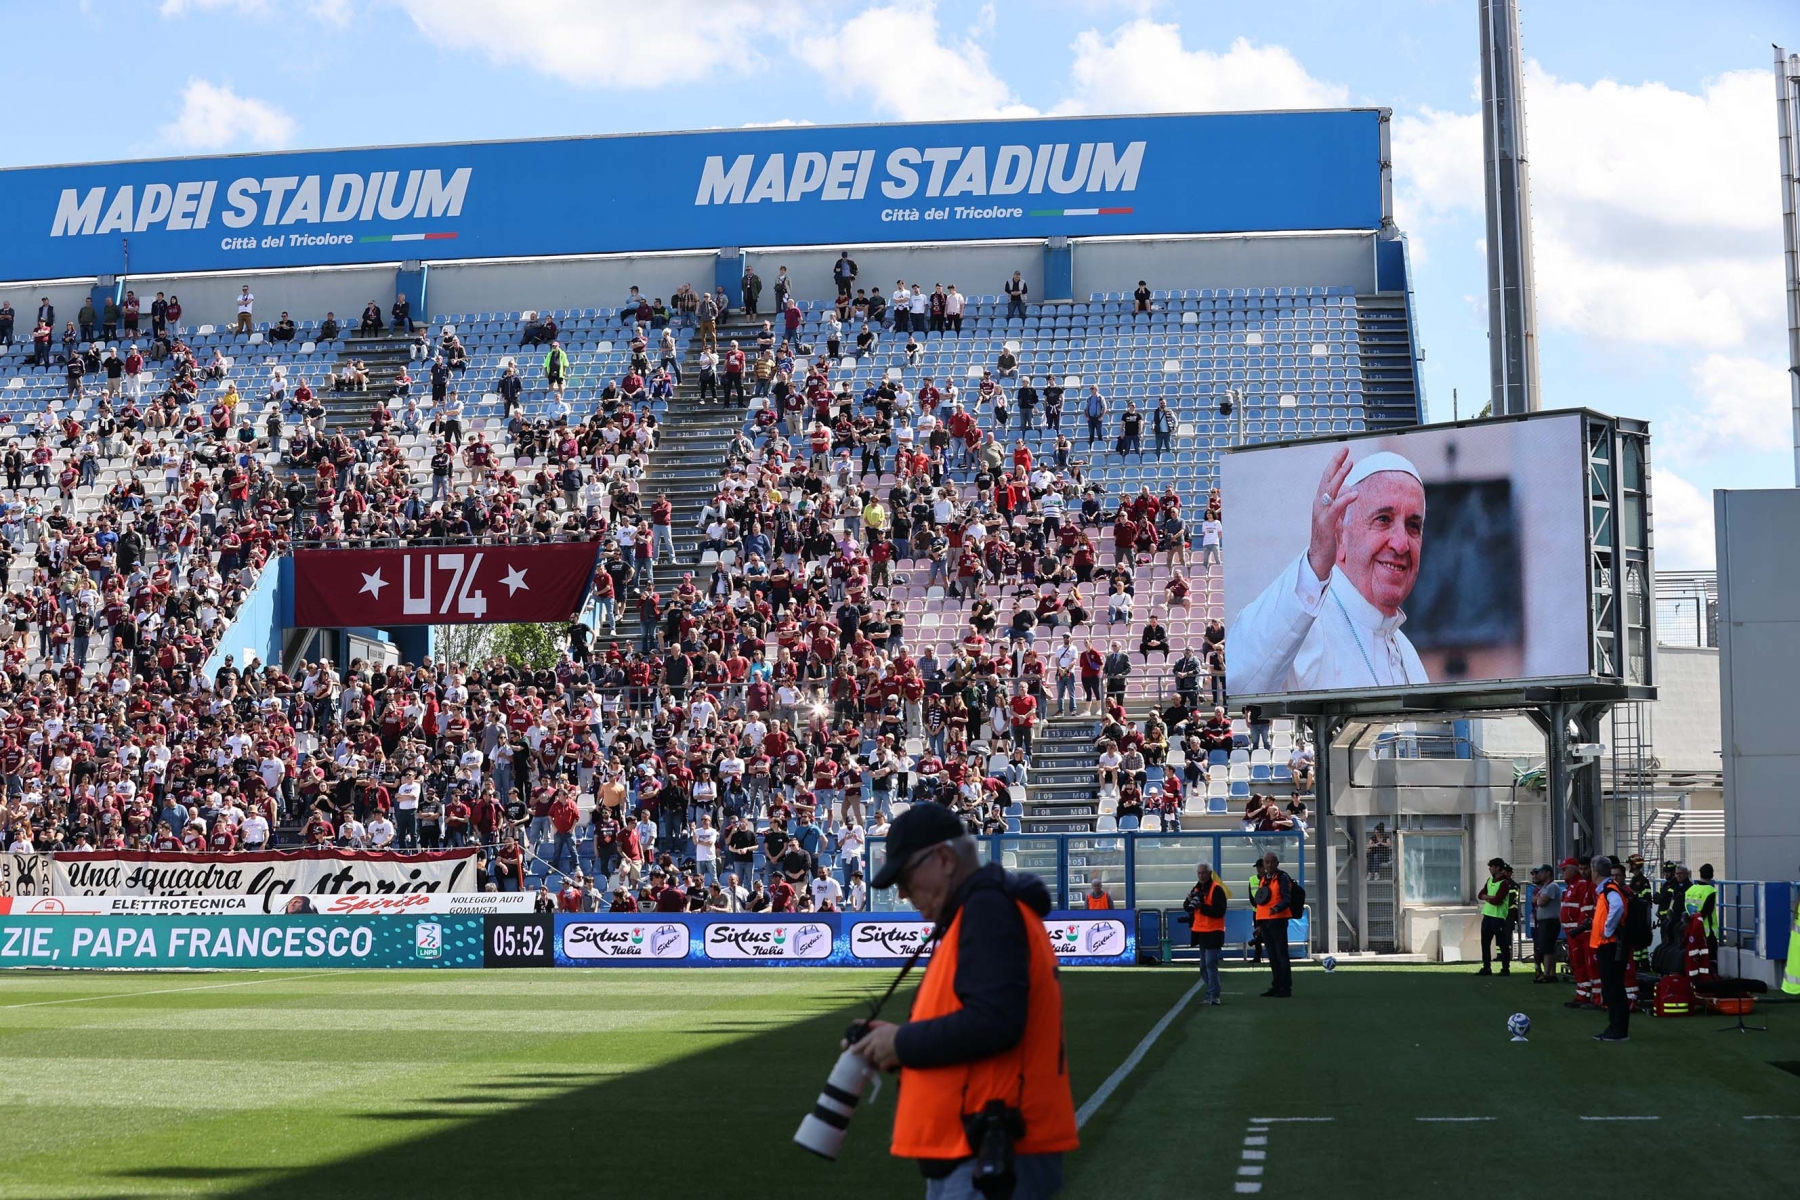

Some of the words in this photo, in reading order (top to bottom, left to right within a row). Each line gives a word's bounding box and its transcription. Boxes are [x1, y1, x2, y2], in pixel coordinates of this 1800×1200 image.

[694, 149, 876, 206] MAPEI
[881, 141, 1147, 200] STADIUM
[50, 180, 220, 238] MAPEI
[221, 168, 473, 229] STADIUM
[880, 206, 920, 222] Città
[924, 206, 949, 221] del
[954, 204, 1023, 220] Tricolore
[220, 236, 258, 251] Città
[261, 234, 285, 249] del
[288, 232, 354, 247] Tricolore
[403, 552, 487, 618] U74
[68, 862, 121, 888] Una
[125, 864, 244, 896] squadra
[112, 898, 246, 910] ELETTROTECNICA
[327, 894, 430, 914] Spirito
[450, 896, 498, 904] NOLEGGIO
[499, 896, 524, 904] AUTO
[450, 906, 498, 914] GOMMISTA
[3, 927, 60, 961] ZIE,
[71, 927, 158, 958] PAPA
[168, 927, 374, 958] FRANCESCO
[493, 925, 544, 958] 05:52
[569, 926, 630, 956] Sixtus
[611, 945, 642, 956] Italia
[710, 926, 772, 956] Sixtus
[752, 946, 784, 956] Italia
[857, 925, 919, 954] Sixtus
[1053, 942, 1077, 954] talia
